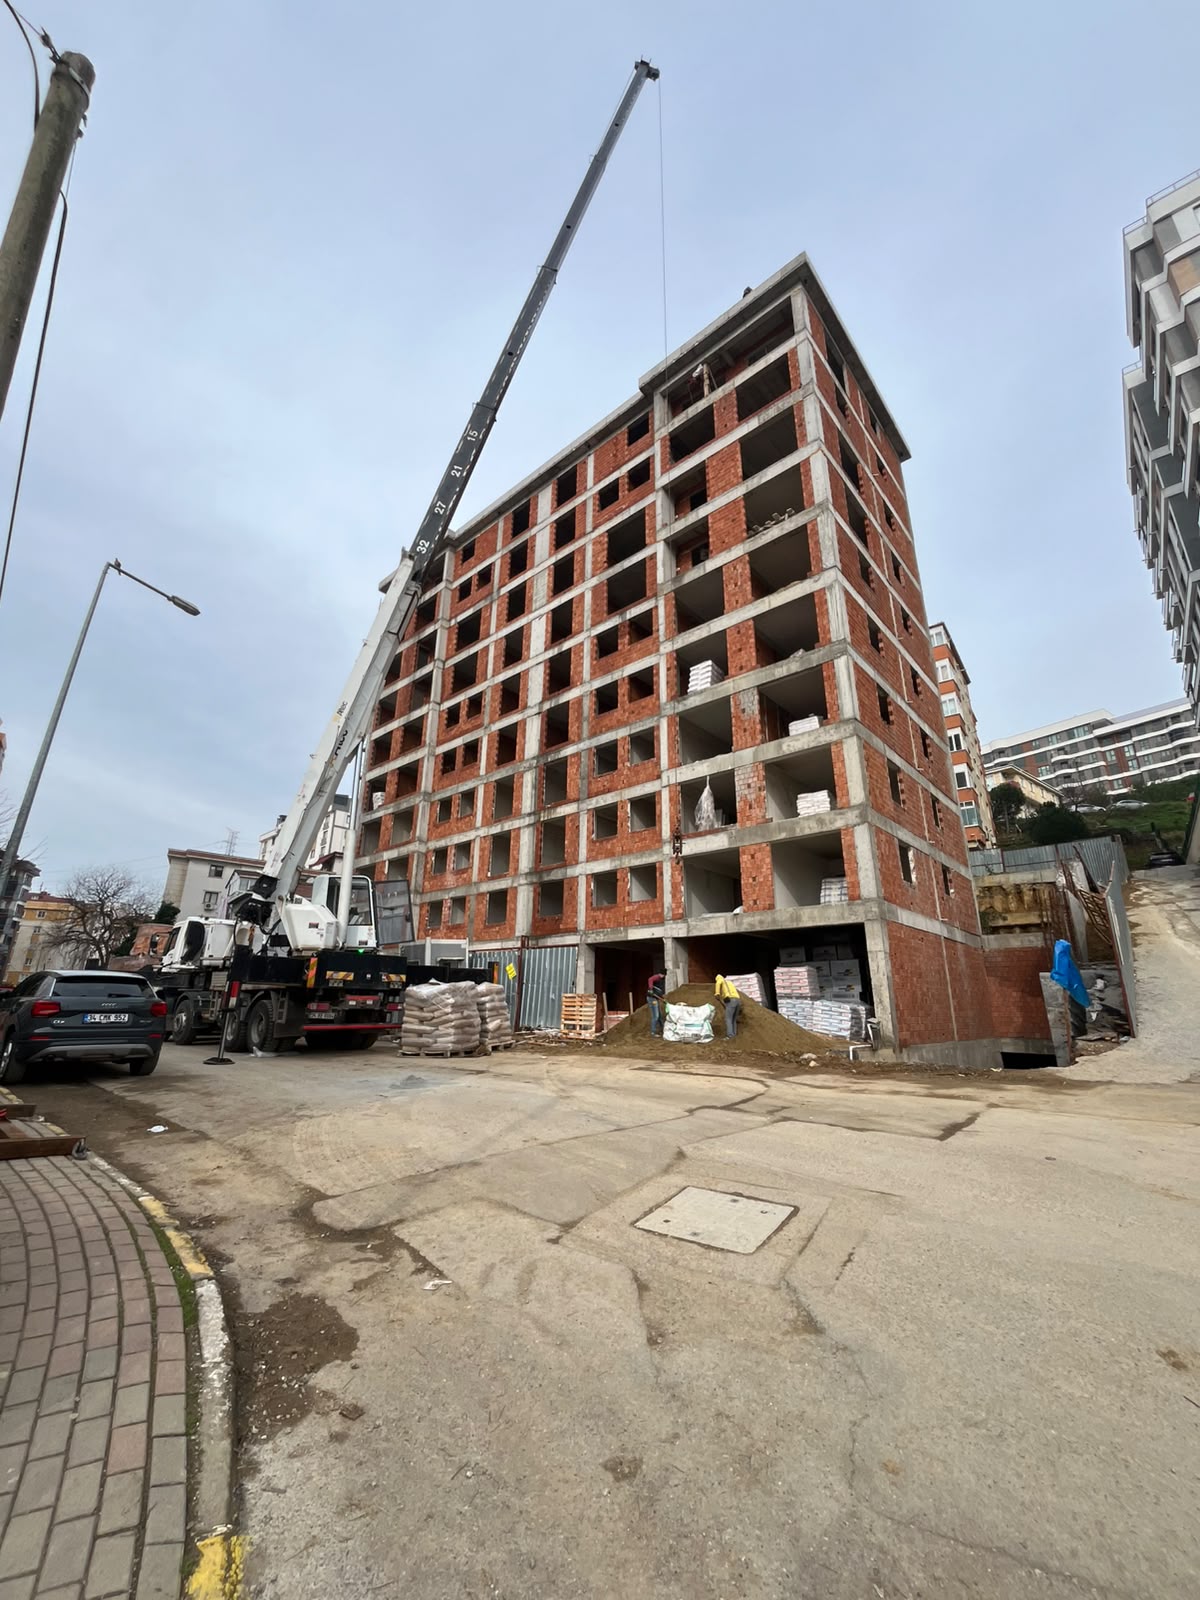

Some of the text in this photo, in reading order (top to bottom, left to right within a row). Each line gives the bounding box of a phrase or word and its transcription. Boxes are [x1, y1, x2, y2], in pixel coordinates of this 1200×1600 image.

[466, 430, 478, 442] 15
[450, 465, 463, 478] 21
[434, 500, 447, 515] 27
[416, 539, 430, 554] 32
